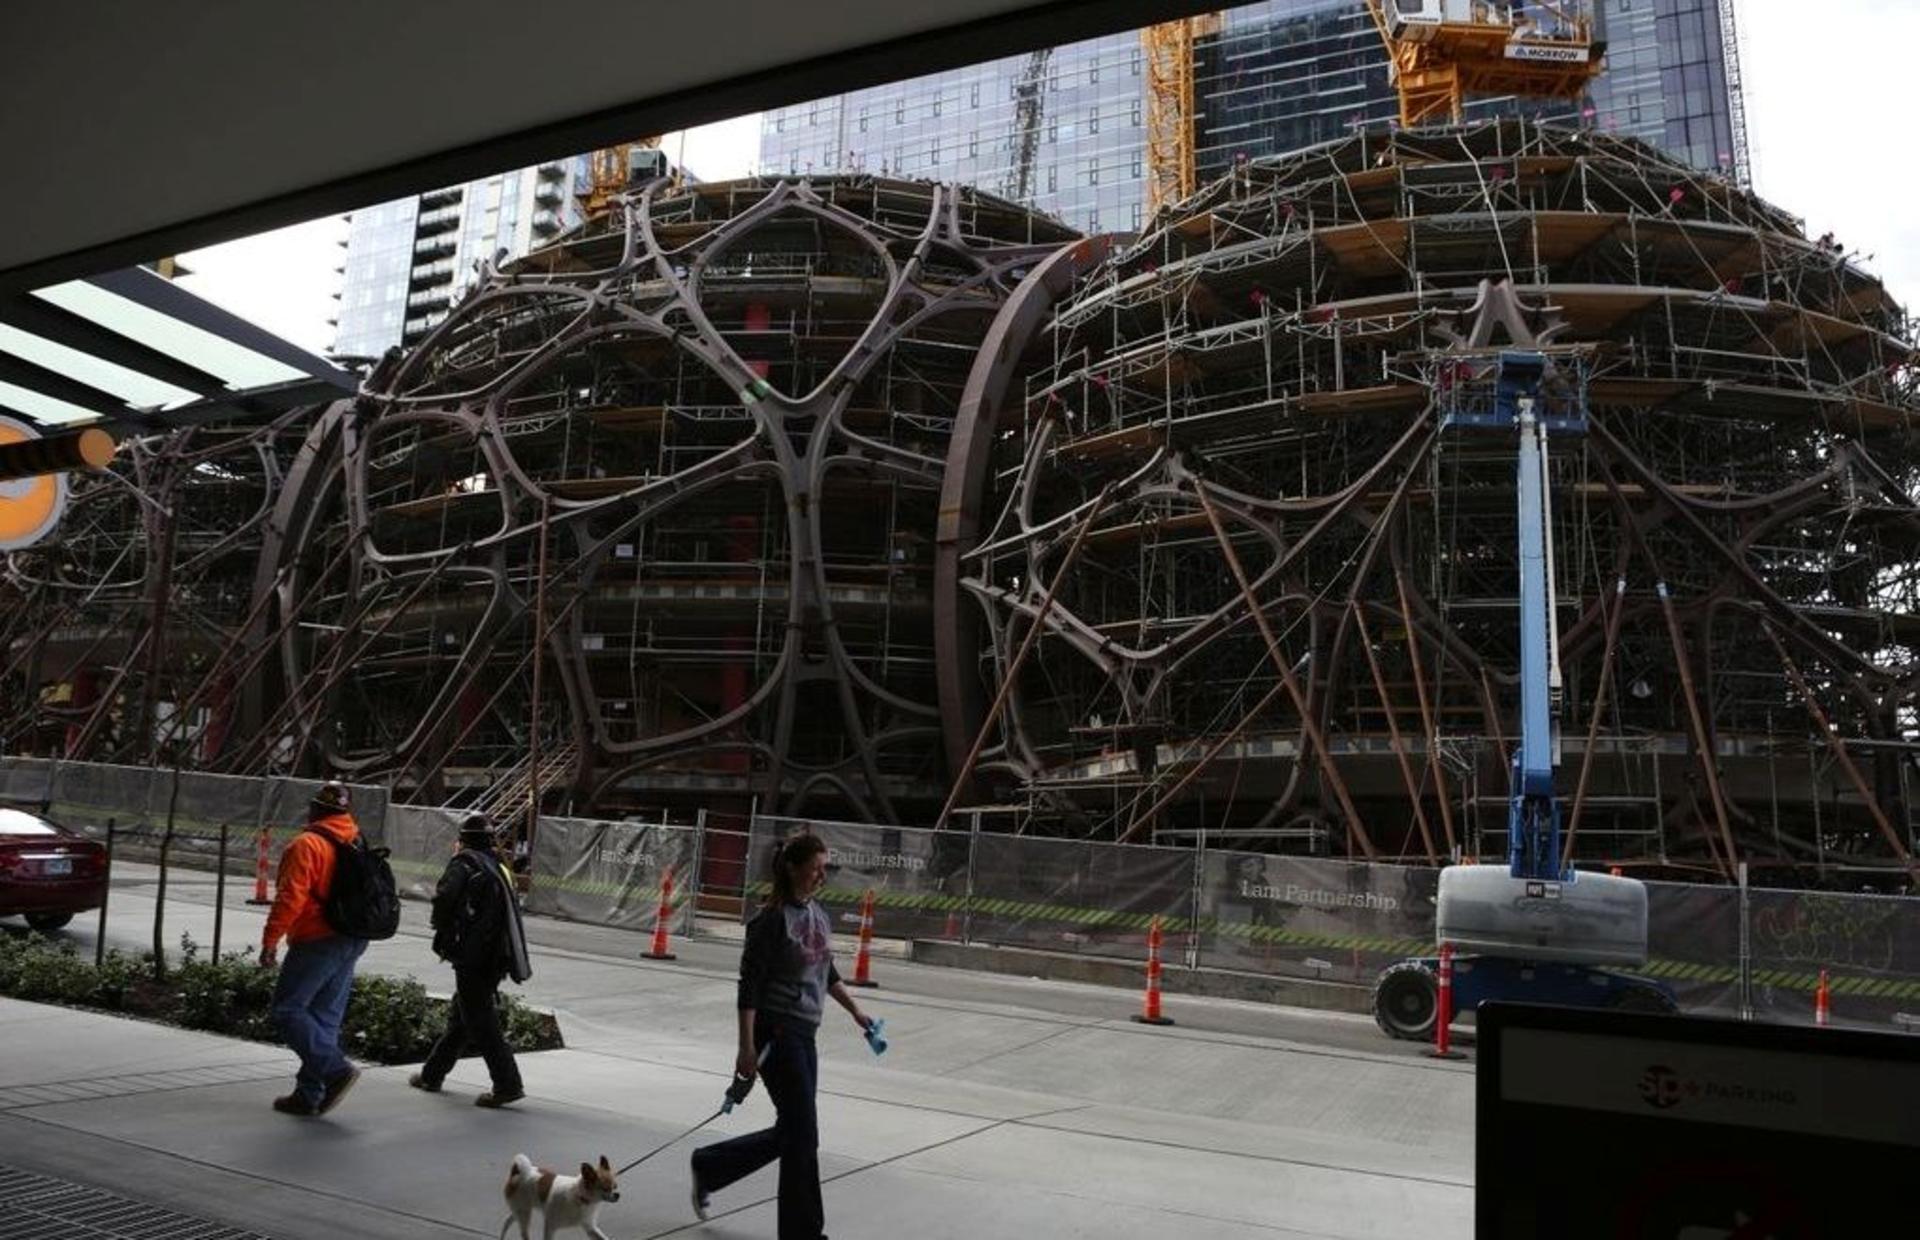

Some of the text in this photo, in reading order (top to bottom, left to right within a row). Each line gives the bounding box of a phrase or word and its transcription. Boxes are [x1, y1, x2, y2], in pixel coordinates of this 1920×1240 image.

[1528, 47, 1579, 59] MORROW
[1241, 879, 1249, 897] I
[1251, 886, 1281, 900] am
